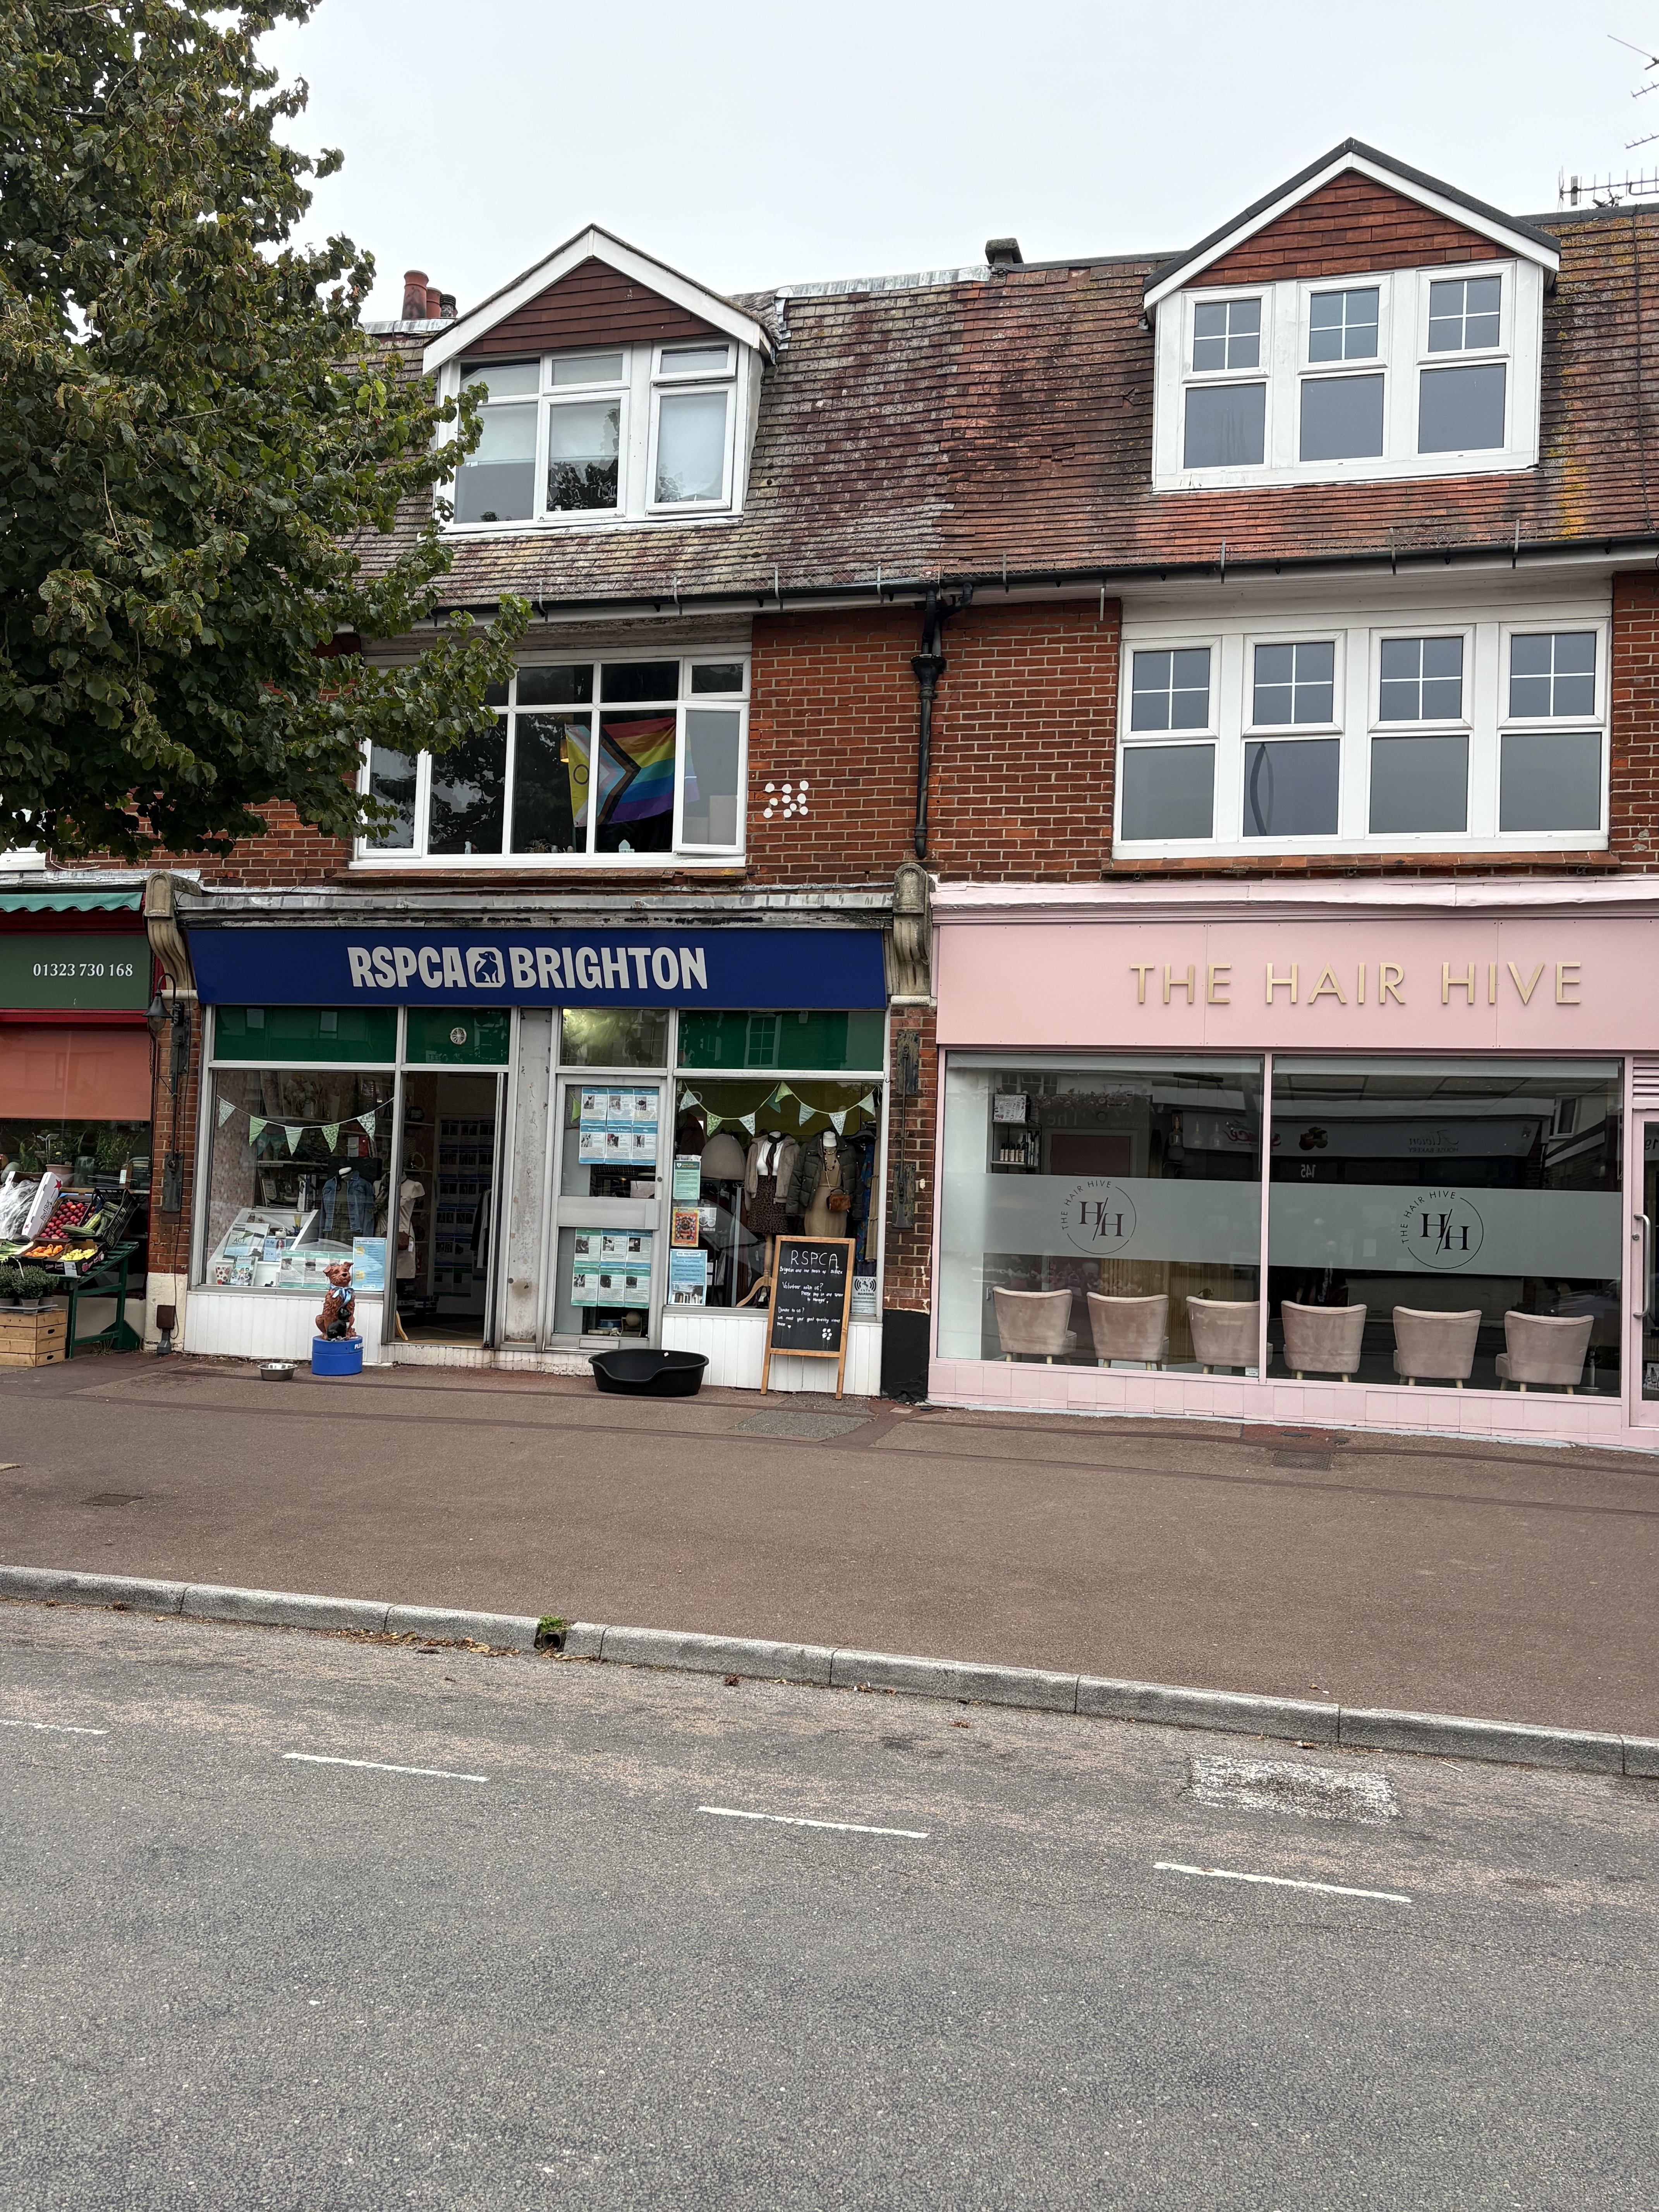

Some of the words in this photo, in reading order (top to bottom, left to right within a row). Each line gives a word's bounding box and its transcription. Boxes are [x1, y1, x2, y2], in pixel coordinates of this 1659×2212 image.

[33, 963, 76, 976] 01323
[79, 963, 104, 976] 730
[109, 963, 133, 976] 168
[347, 946, 467, 988] RSPCA
[508, 946, 708, 989] BRIGHTON
[1129, 963, 1231, 1004] THE
[1266, 962, 1407, 1005] HAIR
[1441, 962, 1582, 1005] HIVE
[1087, 1180, 1111, 1188] HIVE
[1064, 1185, 1084, 1206] HAIR
[1429, 1190, 1456, 1199] HIVE
[1403, 1196, 1425, 1218] HAIR
[1061, 1211, 1069, 1230] THE
[1400, 1223, 1409, 1244] THE
[791, 1250, 838, 1268] RSPCA
